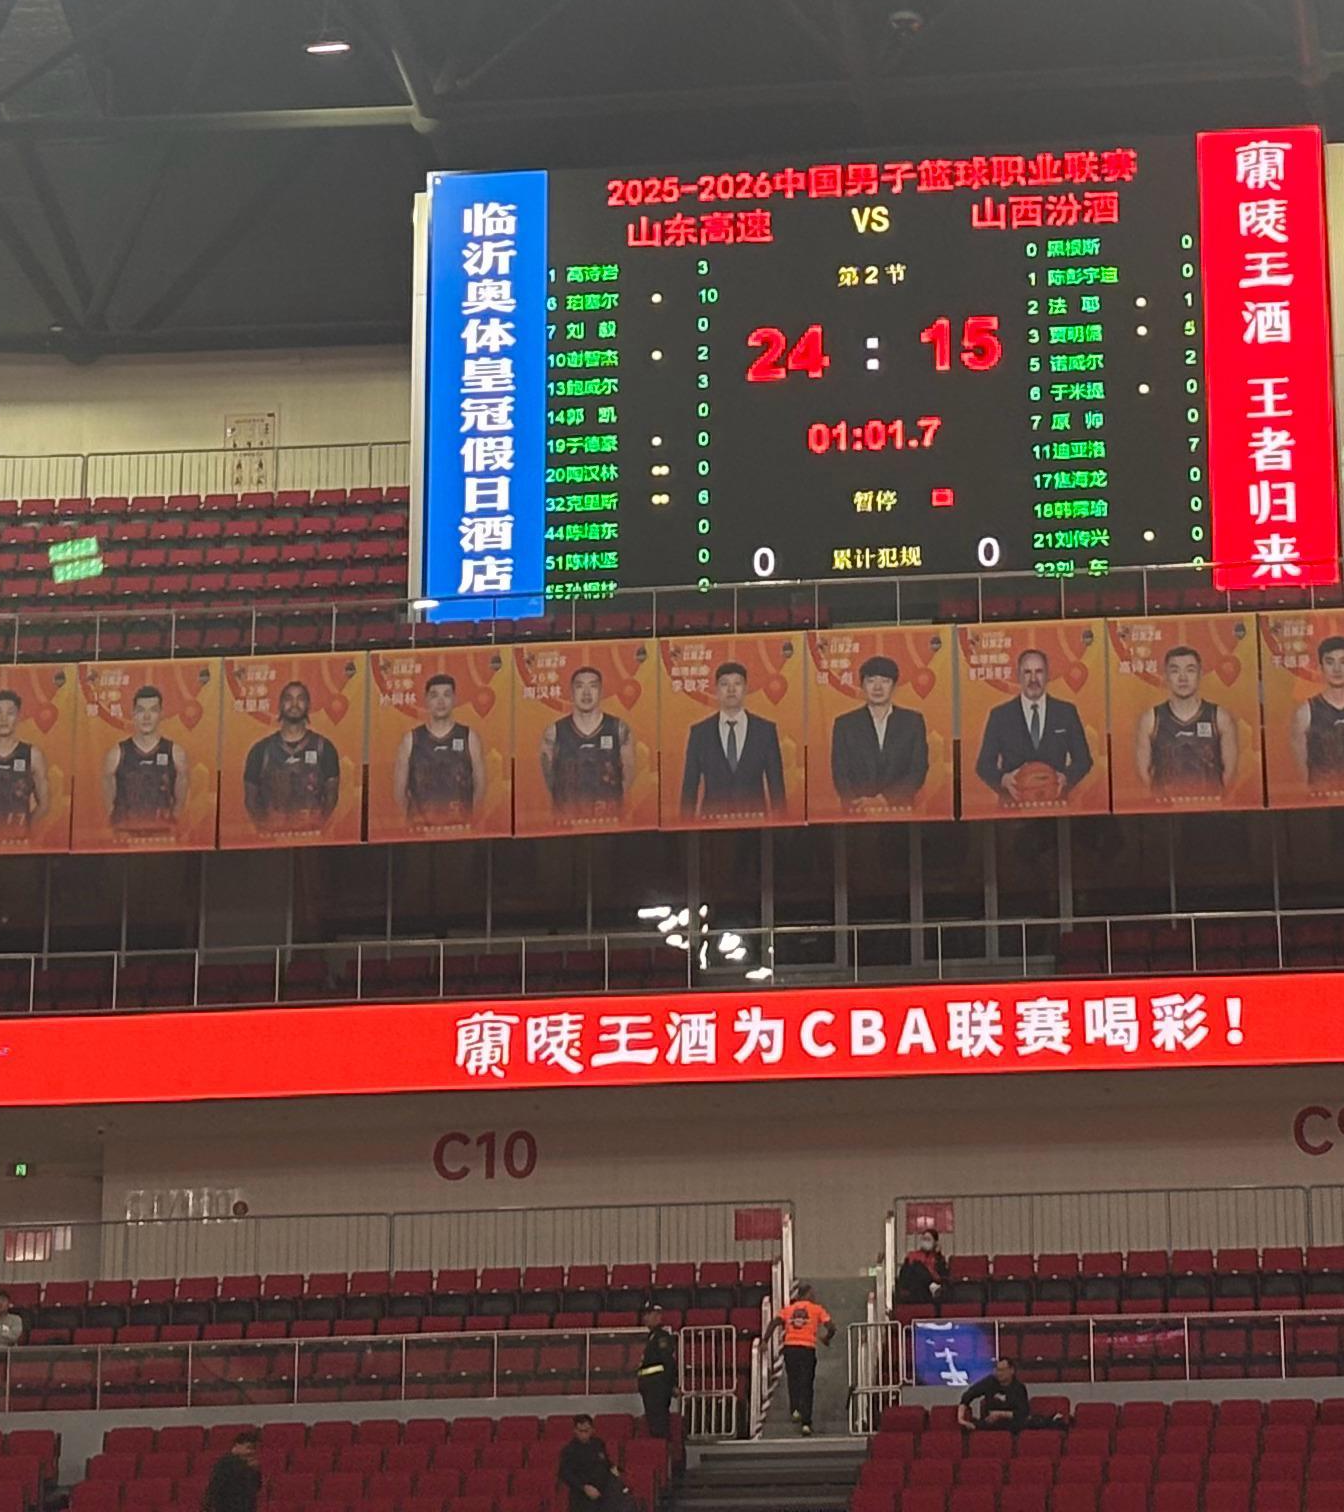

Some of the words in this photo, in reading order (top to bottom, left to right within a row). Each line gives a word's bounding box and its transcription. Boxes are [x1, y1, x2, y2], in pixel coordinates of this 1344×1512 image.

[608, 148, 1138, 207] 2025-2026中国男子篮球职业联赛
[628, 209, 773, 247] 山东高速
[852, 206, 890, 233] VS
[972, 190, 1119, 230] 山西汾酒
[1026, 243, 1037, 257] 0
[1181, 235, 1192, 249] 0
[549, 269, 555, 282] 1
[698, 261, 709, 274] 3
[1028, 273, 1036, 286] 1
[1182, 264, 1193, 277] 0
[699, 289, 718, 303] 10
[1028, 301, 1039, 315] 2
[1184, 293, 1192, 306] 1
[547, 325, 556, 339] 7
[698, 318, 709, 331] 0
[1028, 329, 1040, 343] 3
[1184, 320, 1195, 335] 5
[548, 354, 565, 368] 10
[698, 346, 709, 360] 2
[747, 324, 831, 382] 24
[920, 316, 1003, 371] 15
[1029, 358, 1041, 372] 5
[1185, 350, 1196, 364] 2
[548, 382, 565, 396] 13
[698, 375, 709, 388] 3
[1030, 387, 1041, 401] 6
[1186, 379, 1197, 393] 0
[459, 202, 518, 594] 临沂奥体皇冠假日酒店
[548, 410, 565, 424] 14
[698, 403, 709, 416] 0
[1030, 415, 1042, 430] 7
[1187, 409, 1199, 422] 0
[547, 440, 565, 453] 19
[698, 432, 709, 445] 0
[808, 416, 942, 454] 01:01.7
[1033, 445, 1051, 459] 11
[1188, 438, 1199, 452] 7
[546, 469, 565, 483] 20
[698, 461, 709, 475] 0
[1034, 474, 1052, 488] 17
[1189, 467, 1201, 481] 0
[1247, 377, 1301, 580] 王者归来
[546, 498, 565, 511] 32
[699, 490, 709, 504] 6
[853, 490, 897, 513] 暂停
[1034, 504, 1053, 518] 18
[1190, 497, 1202, 511] 0
[545, 527, 564, 540] 44
[698, 519, 709, 533] 0
[1033, 534, 1053, 548] 21
[1191, 527, 1203, 540] 0
[546, 556, 563, 570] 51
[698, 549, 709, 563] 0
[753, 547, 775, 576] 0
[832, 545, 922, 570] 累计犯规
[977, 537, 1000, 566] 0
[432, 1129, 538, 1181] C10
